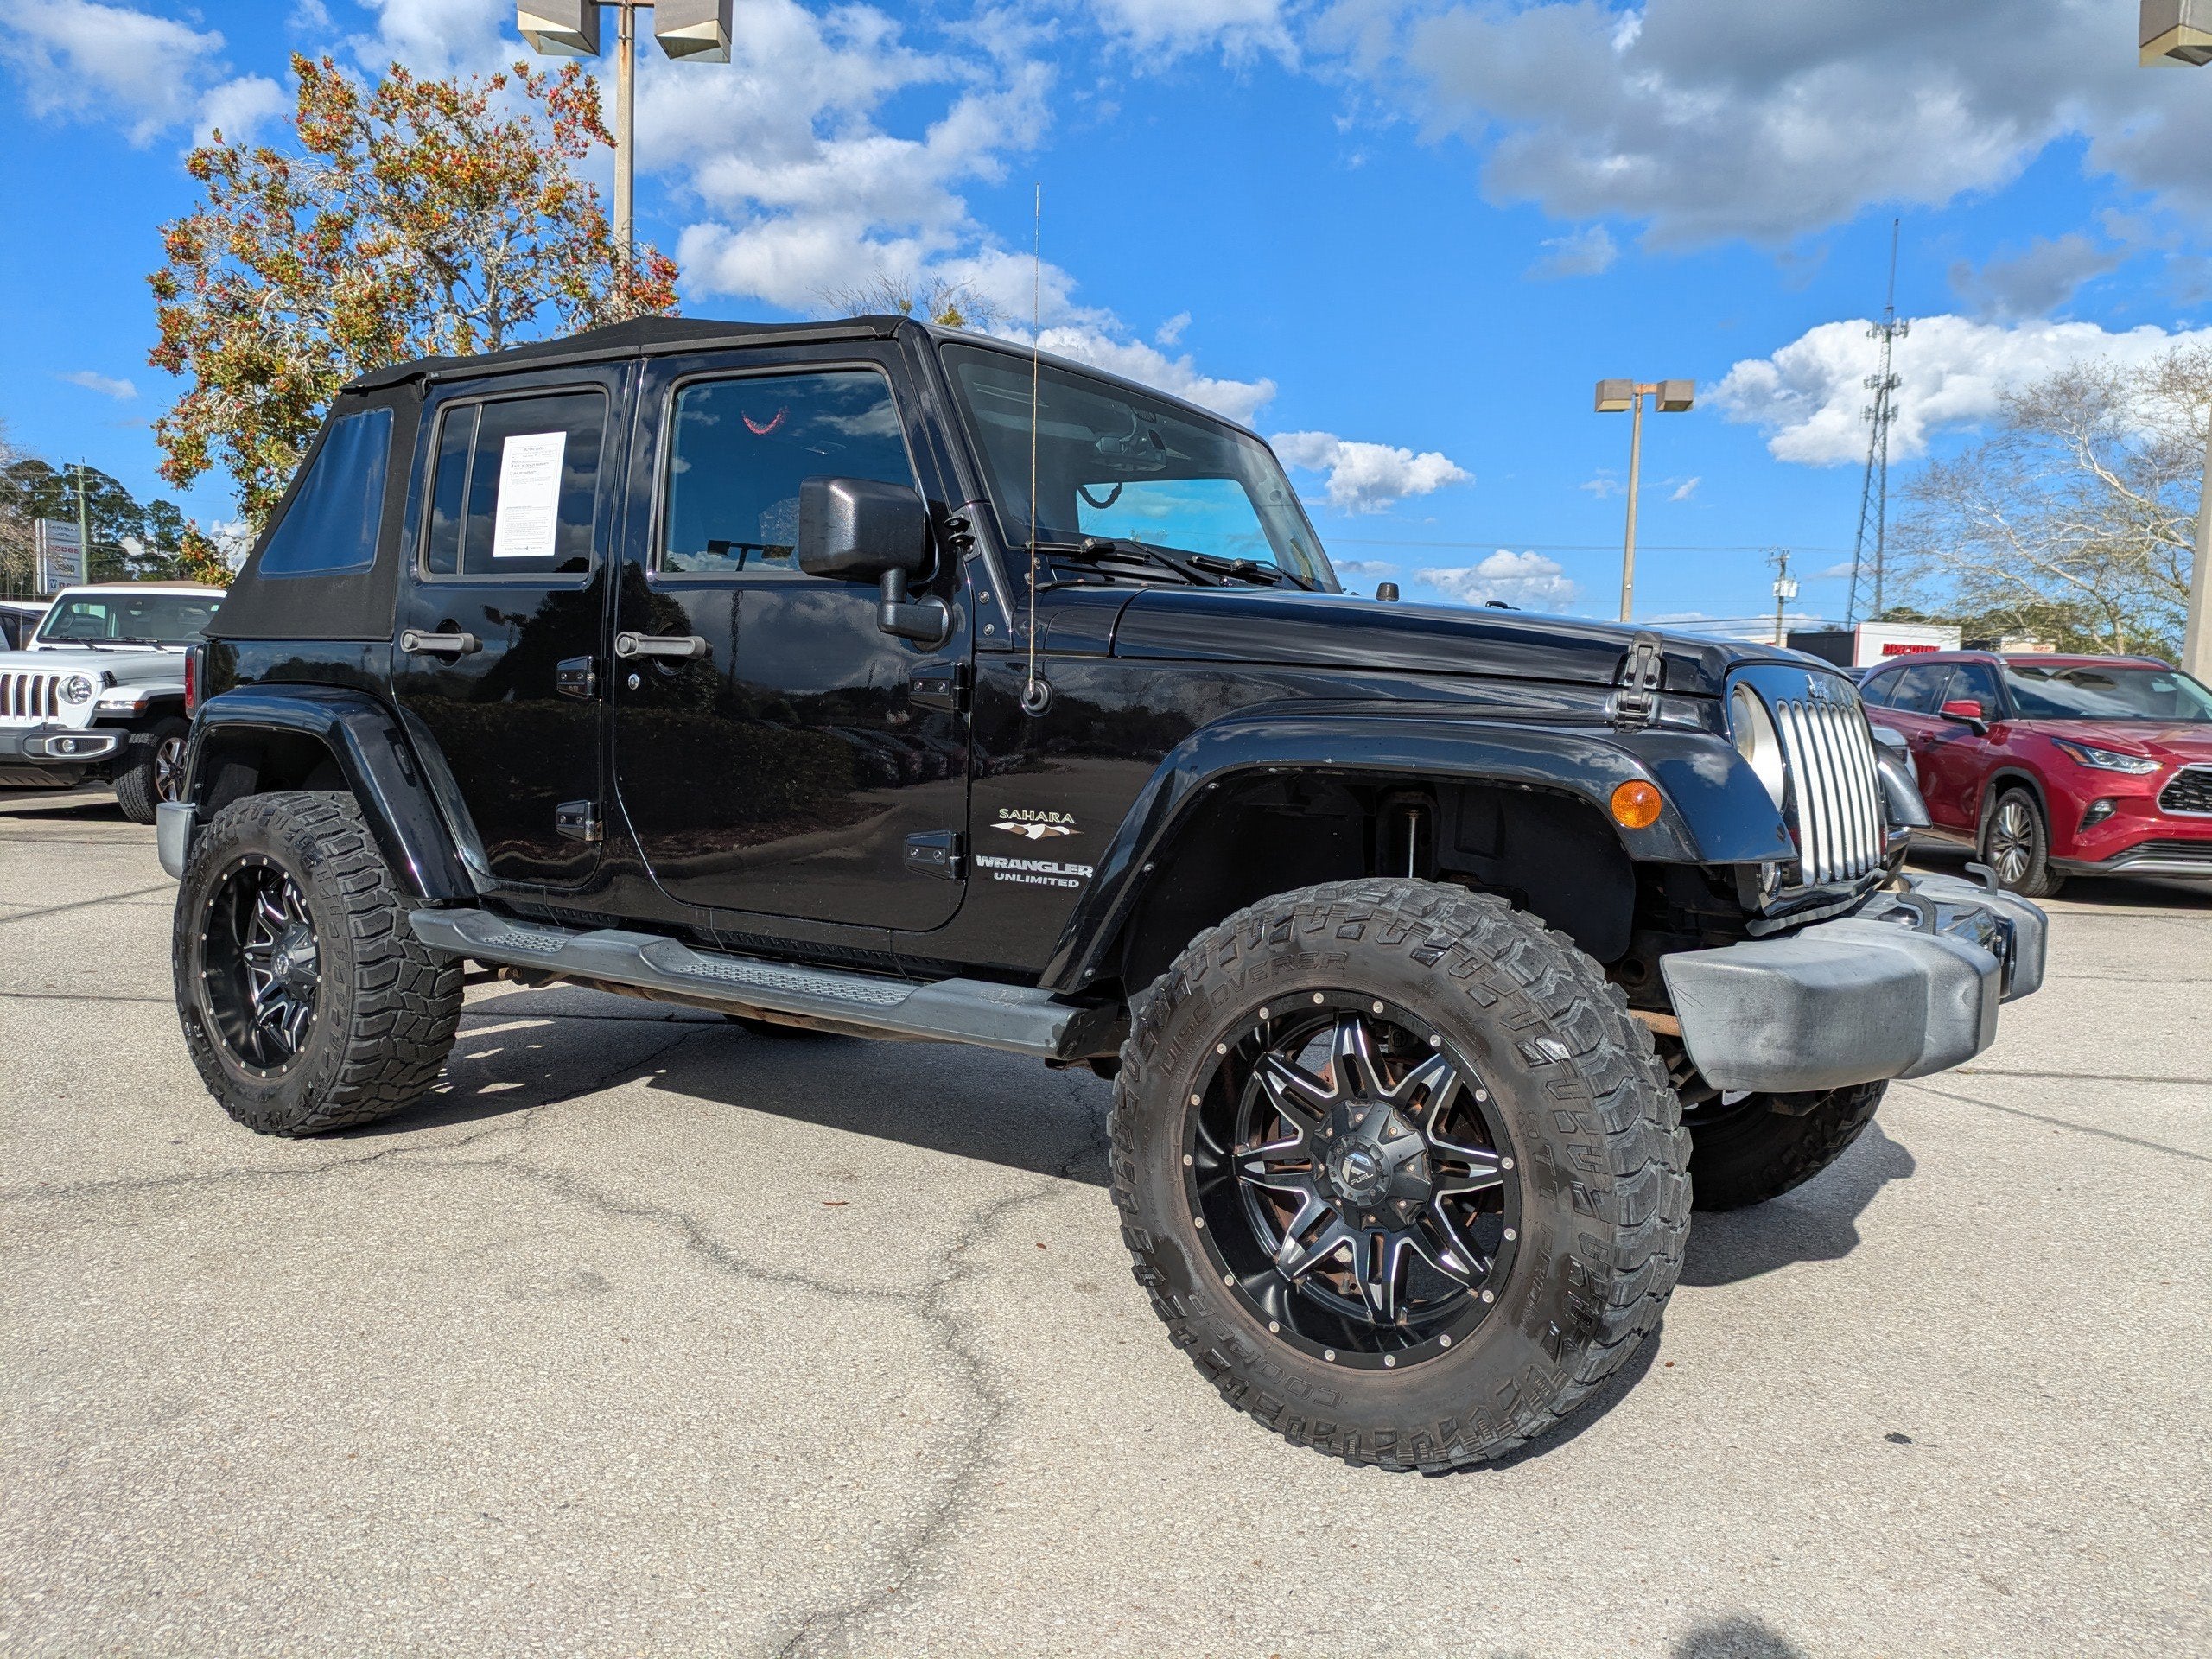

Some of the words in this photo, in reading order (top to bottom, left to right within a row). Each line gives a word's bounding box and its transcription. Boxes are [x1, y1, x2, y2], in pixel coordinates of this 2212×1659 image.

[998, 808, 1077, 824] SAHARA
[975, 855, 1094, 878] WRANGLER
[994, 872, 1080, 887] UNLIMITED
[1160, 950, 1349, 1077] DISCOVERER
[1351, 1173, 1374, 1185] FUEL
